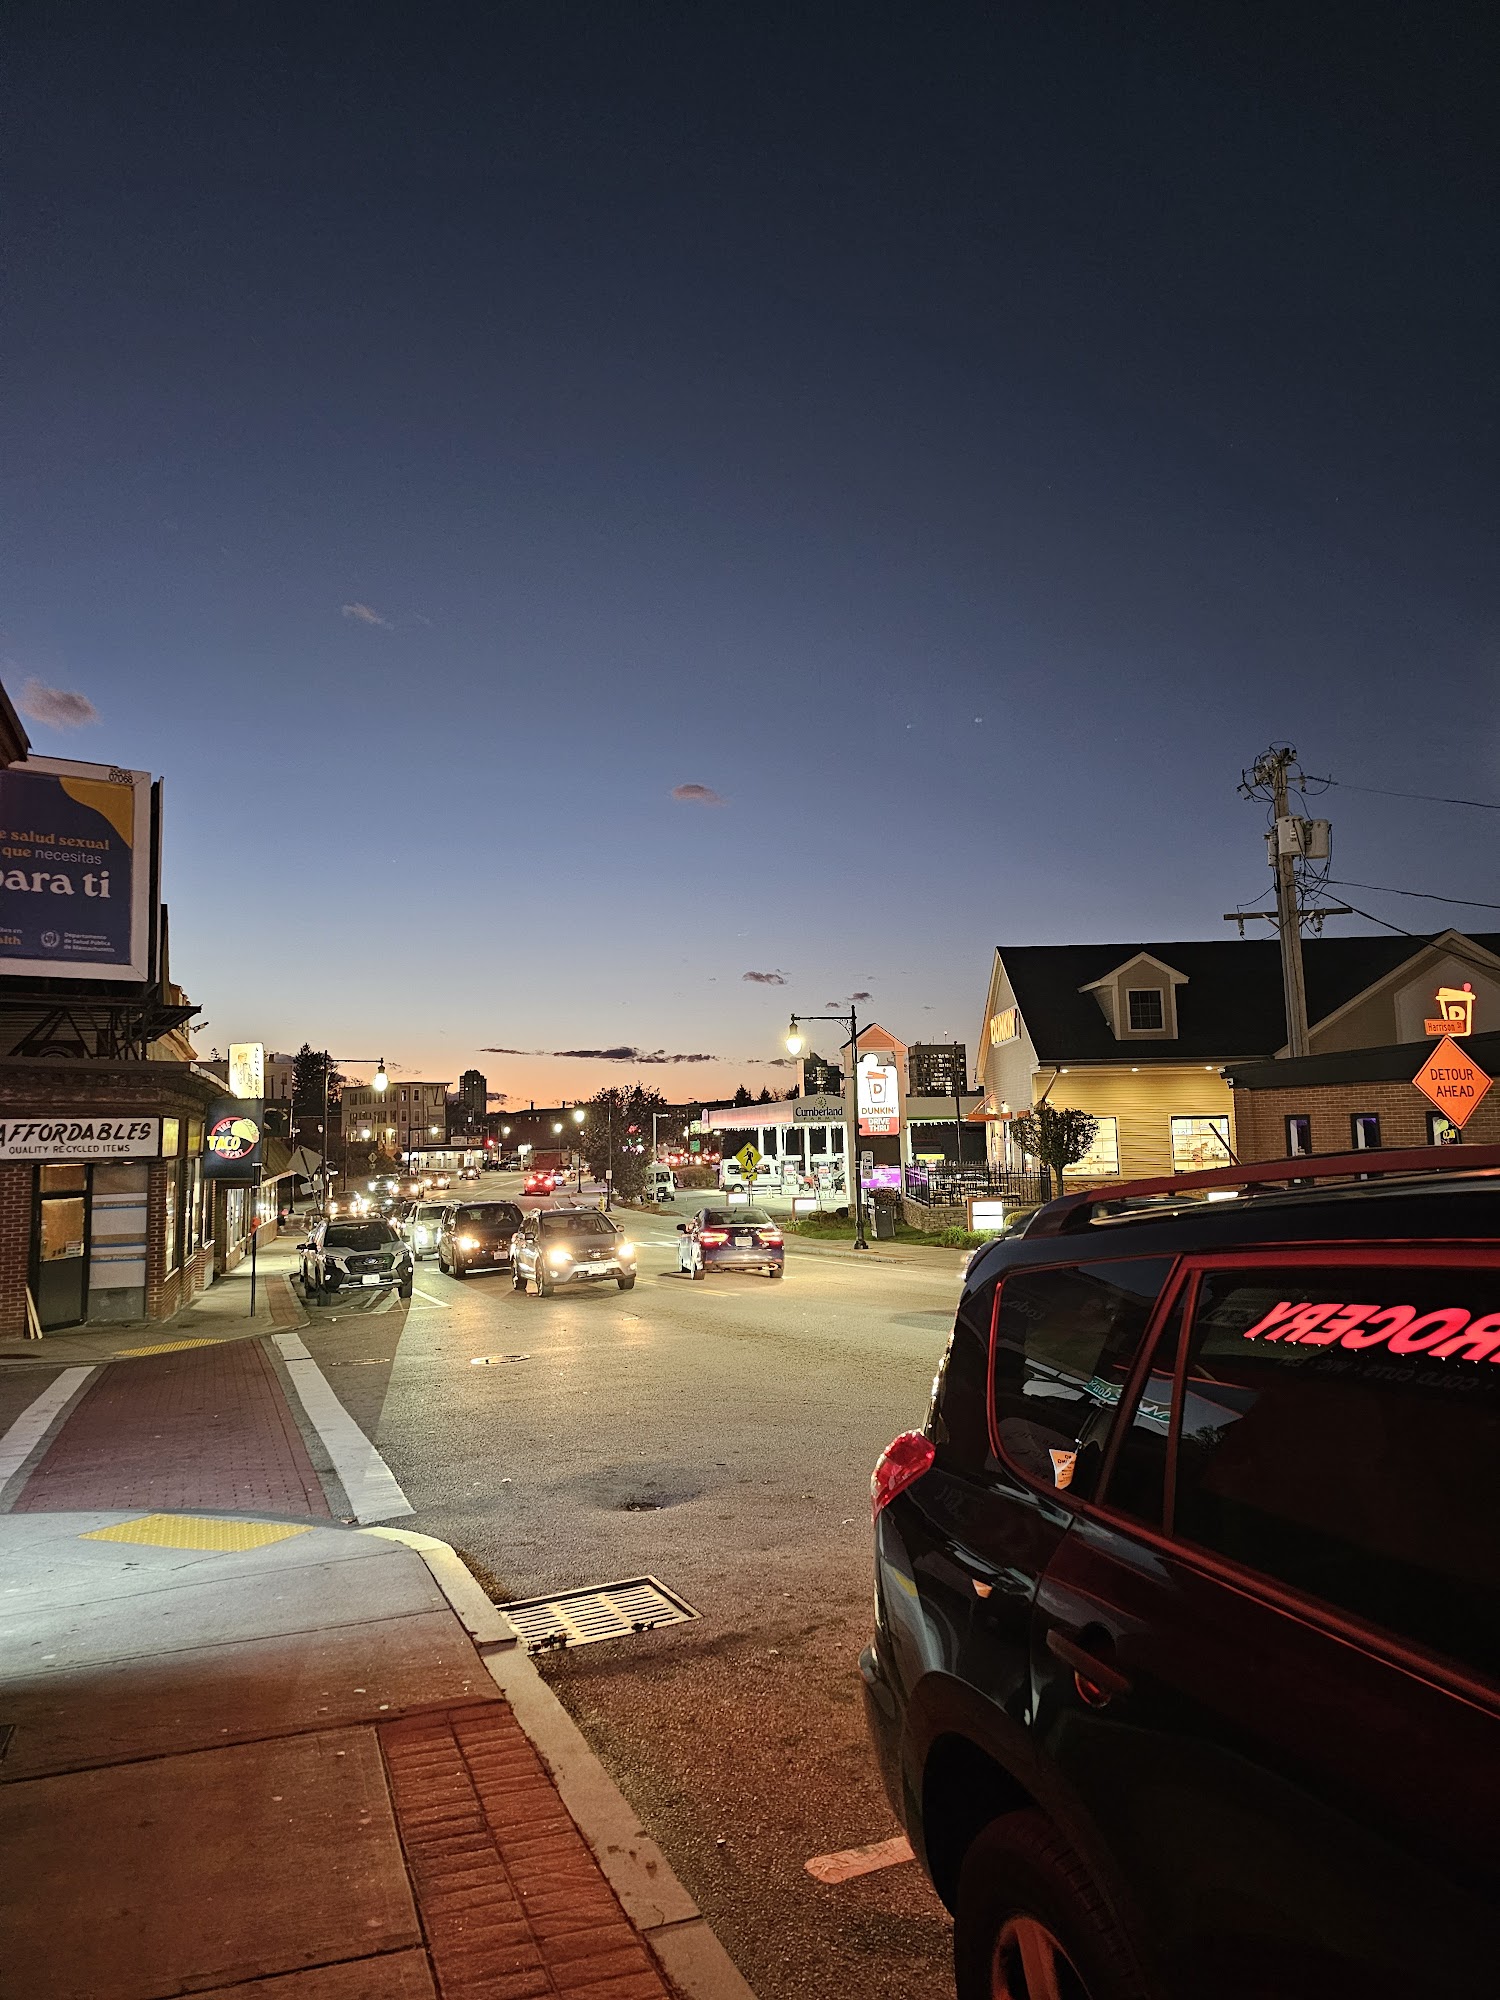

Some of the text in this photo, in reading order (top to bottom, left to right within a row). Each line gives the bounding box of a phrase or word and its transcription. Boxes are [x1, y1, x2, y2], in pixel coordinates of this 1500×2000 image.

[11, 831, 55, 844] salud
[59, 837, 110, 850] sexual
[2, 847, 102, 865] que necesitas
[82, 870, 111, 898] ti
[1428, 1022, 1455, 1032] Harrison
[1430, 1068, 1475, 1081] DETOUR
[1436, 1085, 1475, 1098] AHEAD
[795, 1106, 843, 1117] Cumberland
[861, 1107, 896, 1115] DUNKIN'
[867, 1117, 891, 1125] DRIVE
[868, 1124, 890, 1132] THRU
[207, 1135, 241, 1150] TACO
[9, 1144, 130, 1155] QUALITY RECYCLED ITEMS
